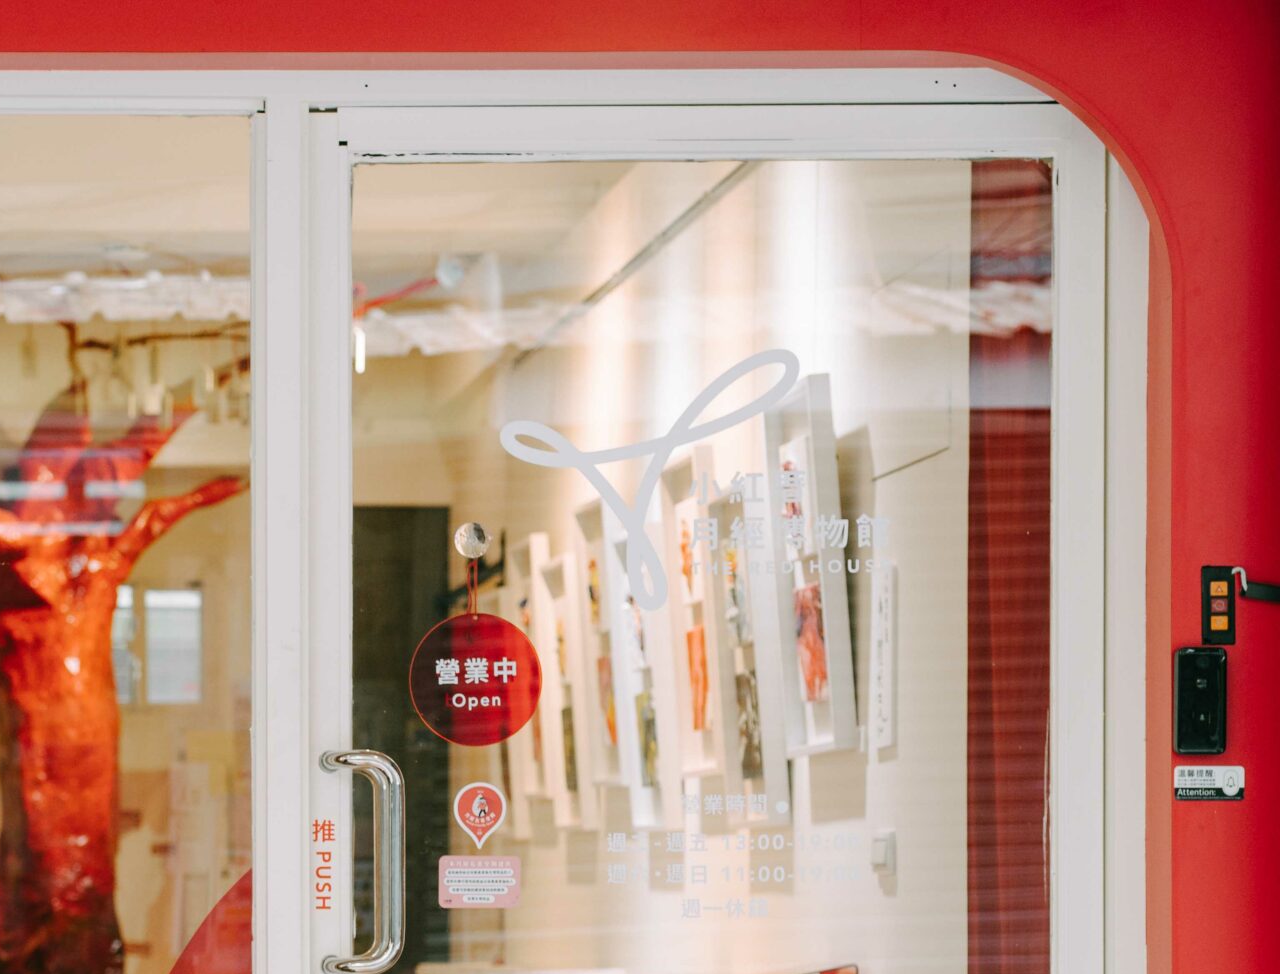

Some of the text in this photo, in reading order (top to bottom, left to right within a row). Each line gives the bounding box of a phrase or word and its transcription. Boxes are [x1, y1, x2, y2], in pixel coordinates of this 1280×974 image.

[809, 558, 892, 574] HOUS
[435, 656, 517, 685] 營業中
[451, 693, 501, 711] Open
[312, 819, 336, 910] 推 PUSH
